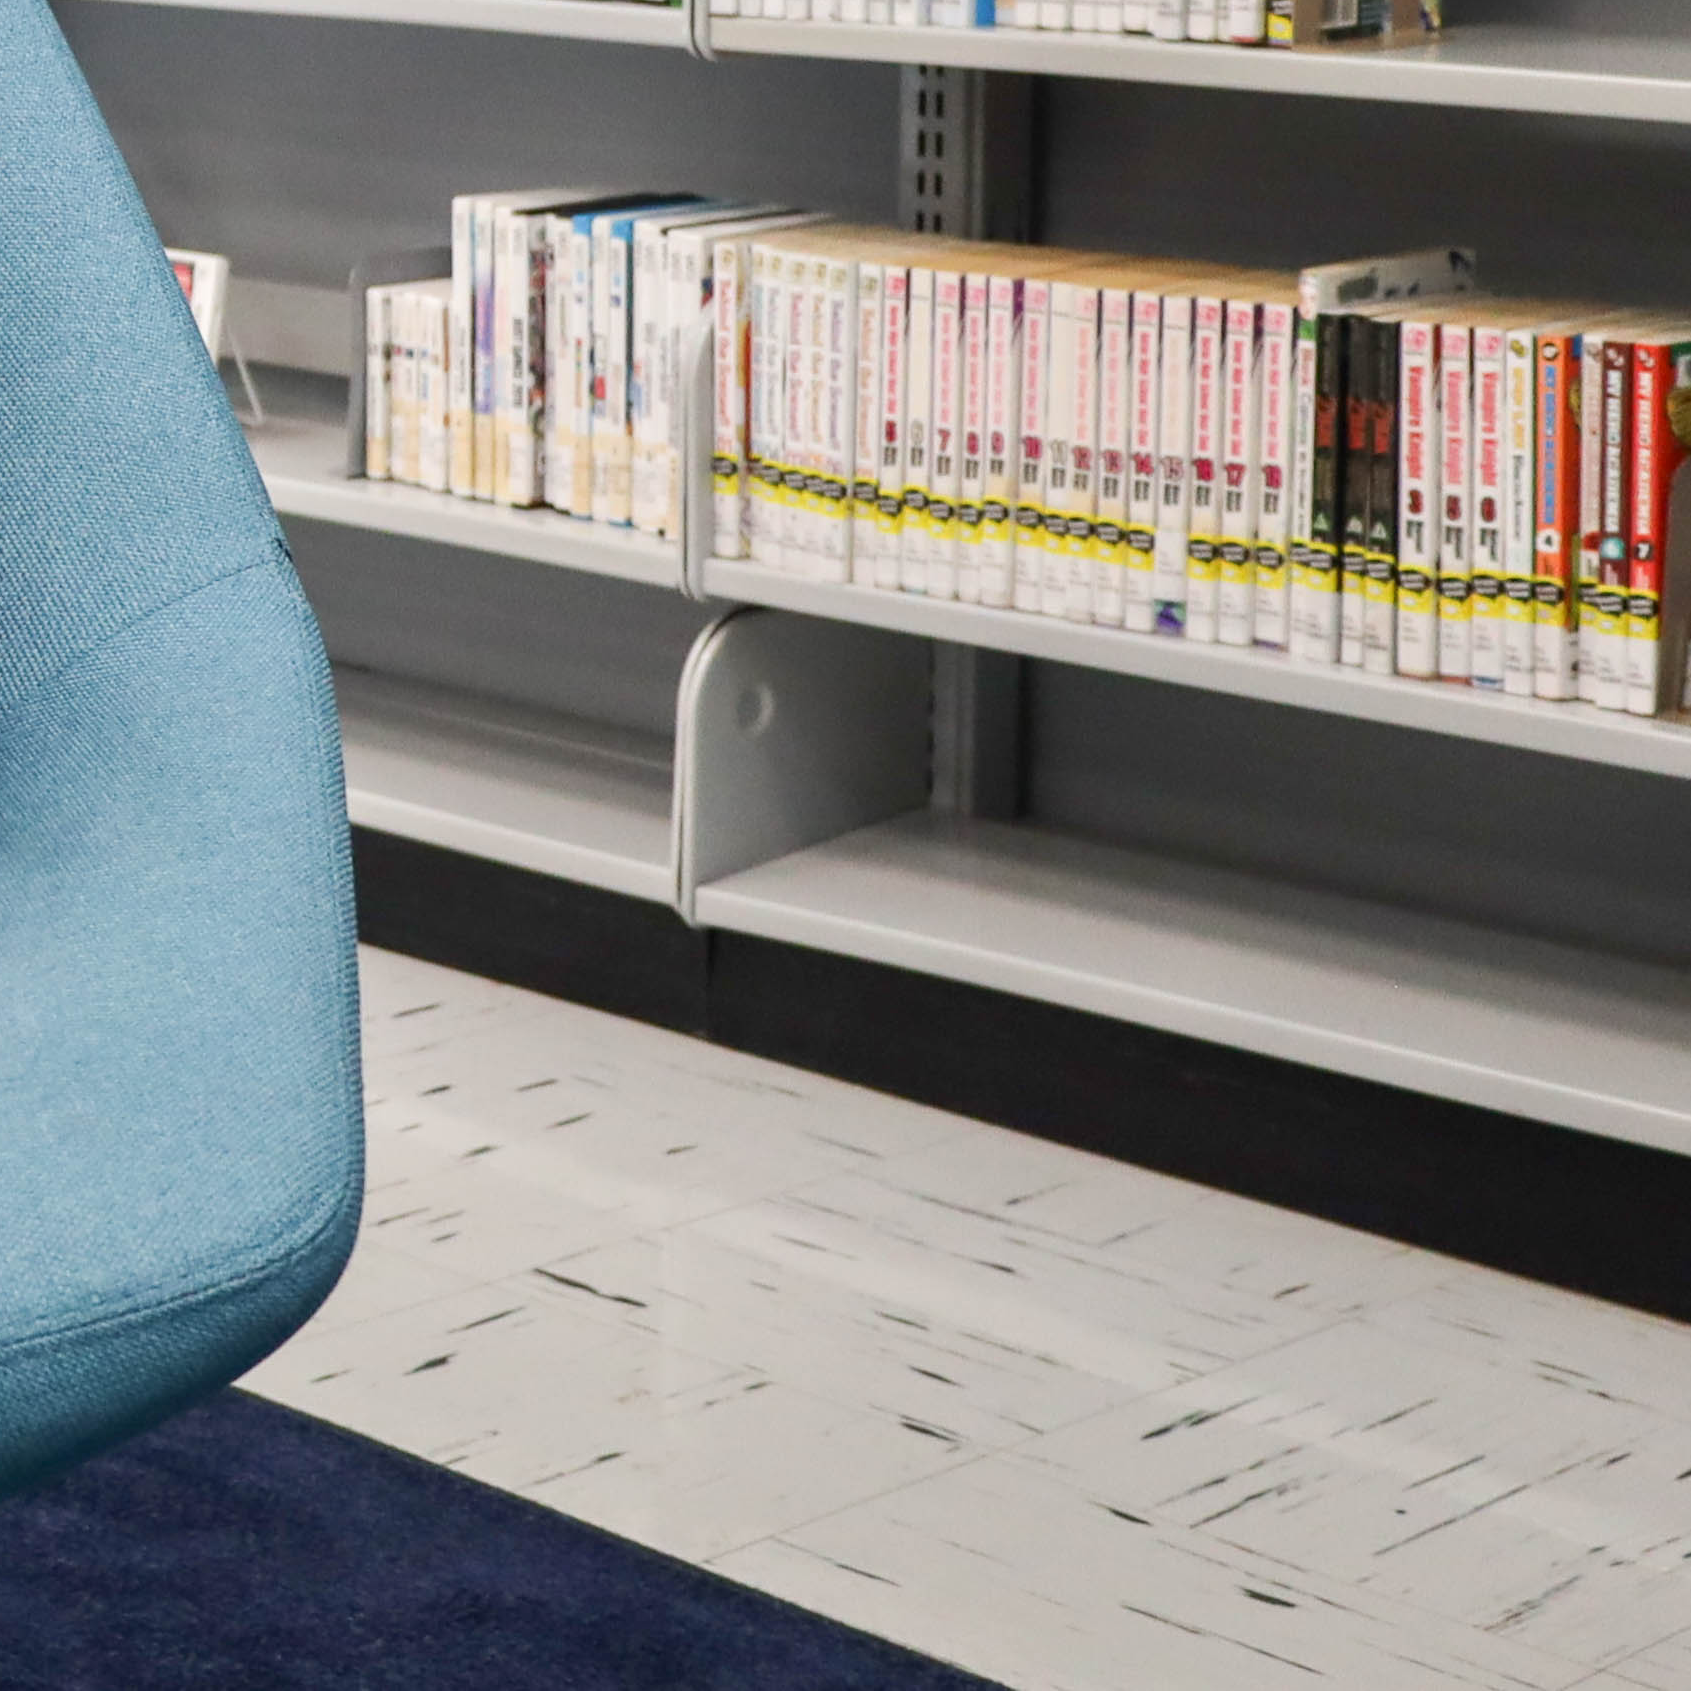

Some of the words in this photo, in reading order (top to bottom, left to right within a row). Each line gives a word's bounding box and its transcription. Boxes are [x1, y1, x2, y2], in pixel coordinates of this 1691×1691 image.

[1406, 366, 1425, 427] Vampire
[1444, 370, 1464, 432] Vampire
[1477, 372, 1500, 434] Vampire
[1607, 370, 1622, 396] MY
[1639, 372, 1653, 397] MY
[937, 428, 952, 452] 7
[1607, 398, 1621, 445] HERO
[1639, 399, 1653, 444] HERO
[1224, 463, 1246, 487] 17
[1406, 432, 1426, 481] Knight
[1444, 436, 1464, 485] Knight
[1479, 438, 1501, 487] Knight
[1606, 446, 1621, 533] ACADEMIA
[1637, 448, 1653, 536] ACADEMIA
[1544, 535, 1552, 546] 4
[1638, 544, 1648, 558] 7
